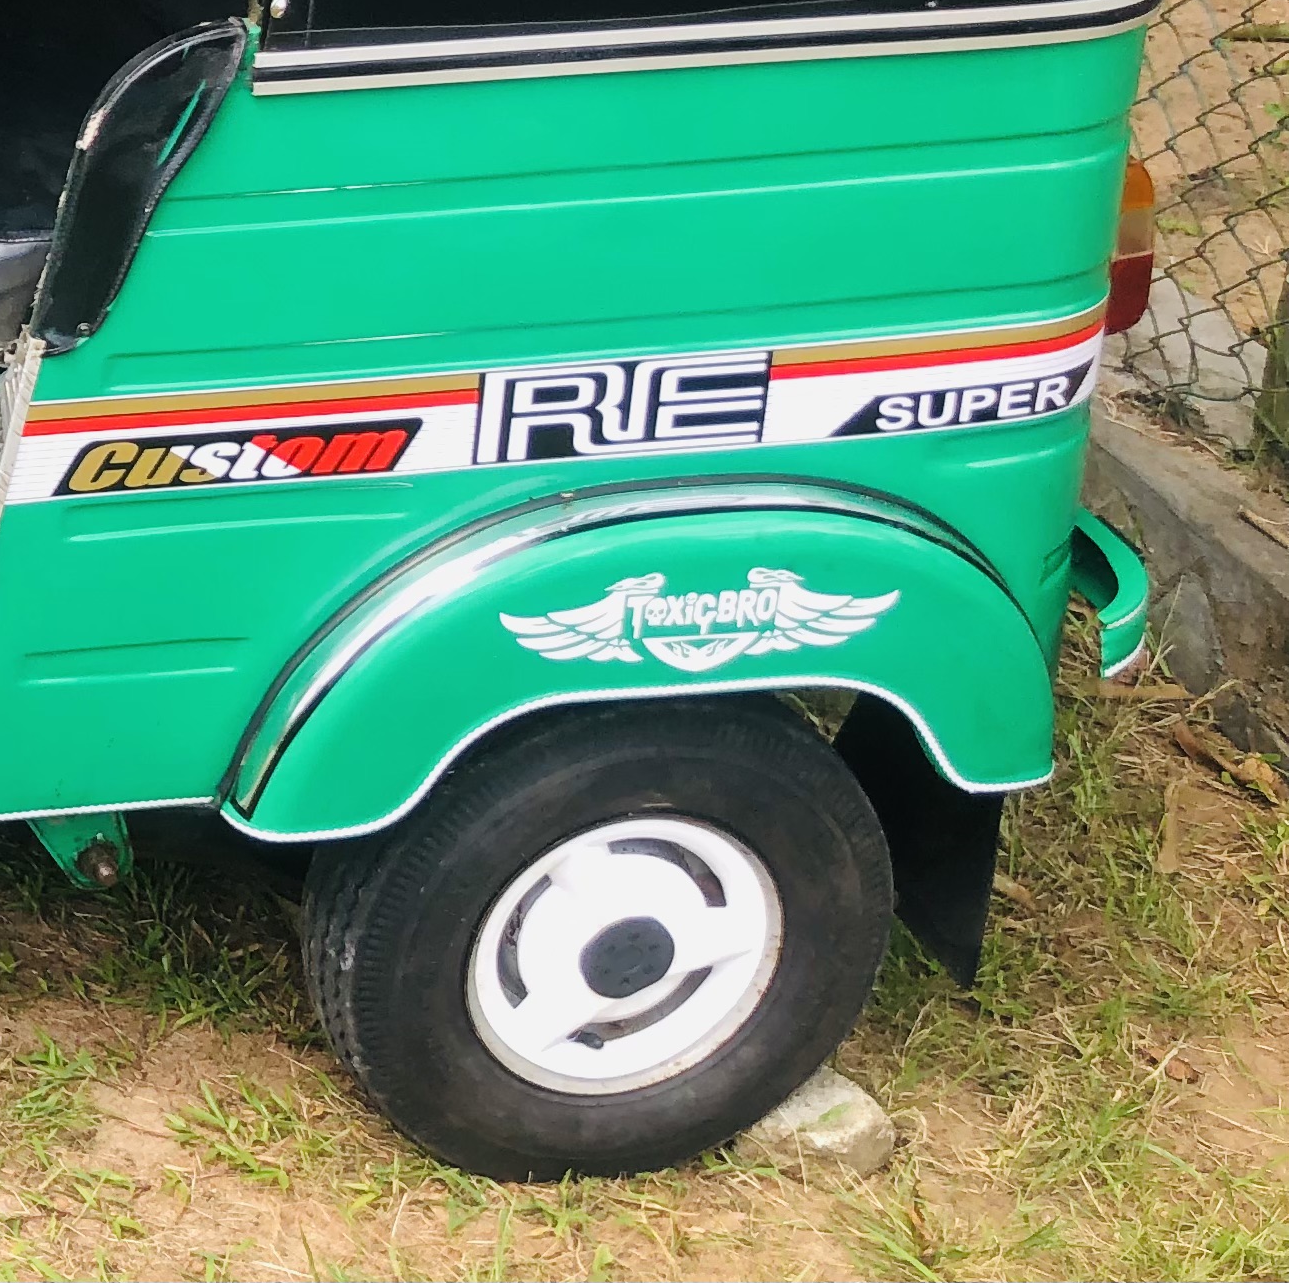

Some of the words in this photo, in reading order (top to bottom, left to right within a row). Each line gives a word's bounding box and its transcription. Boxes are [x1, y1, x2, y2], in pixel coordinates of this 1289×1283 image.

[476, 352, 769, 463] RE
[875, 375, 1070, 432] SUPER
[68, 429, 409, 492] Custom
